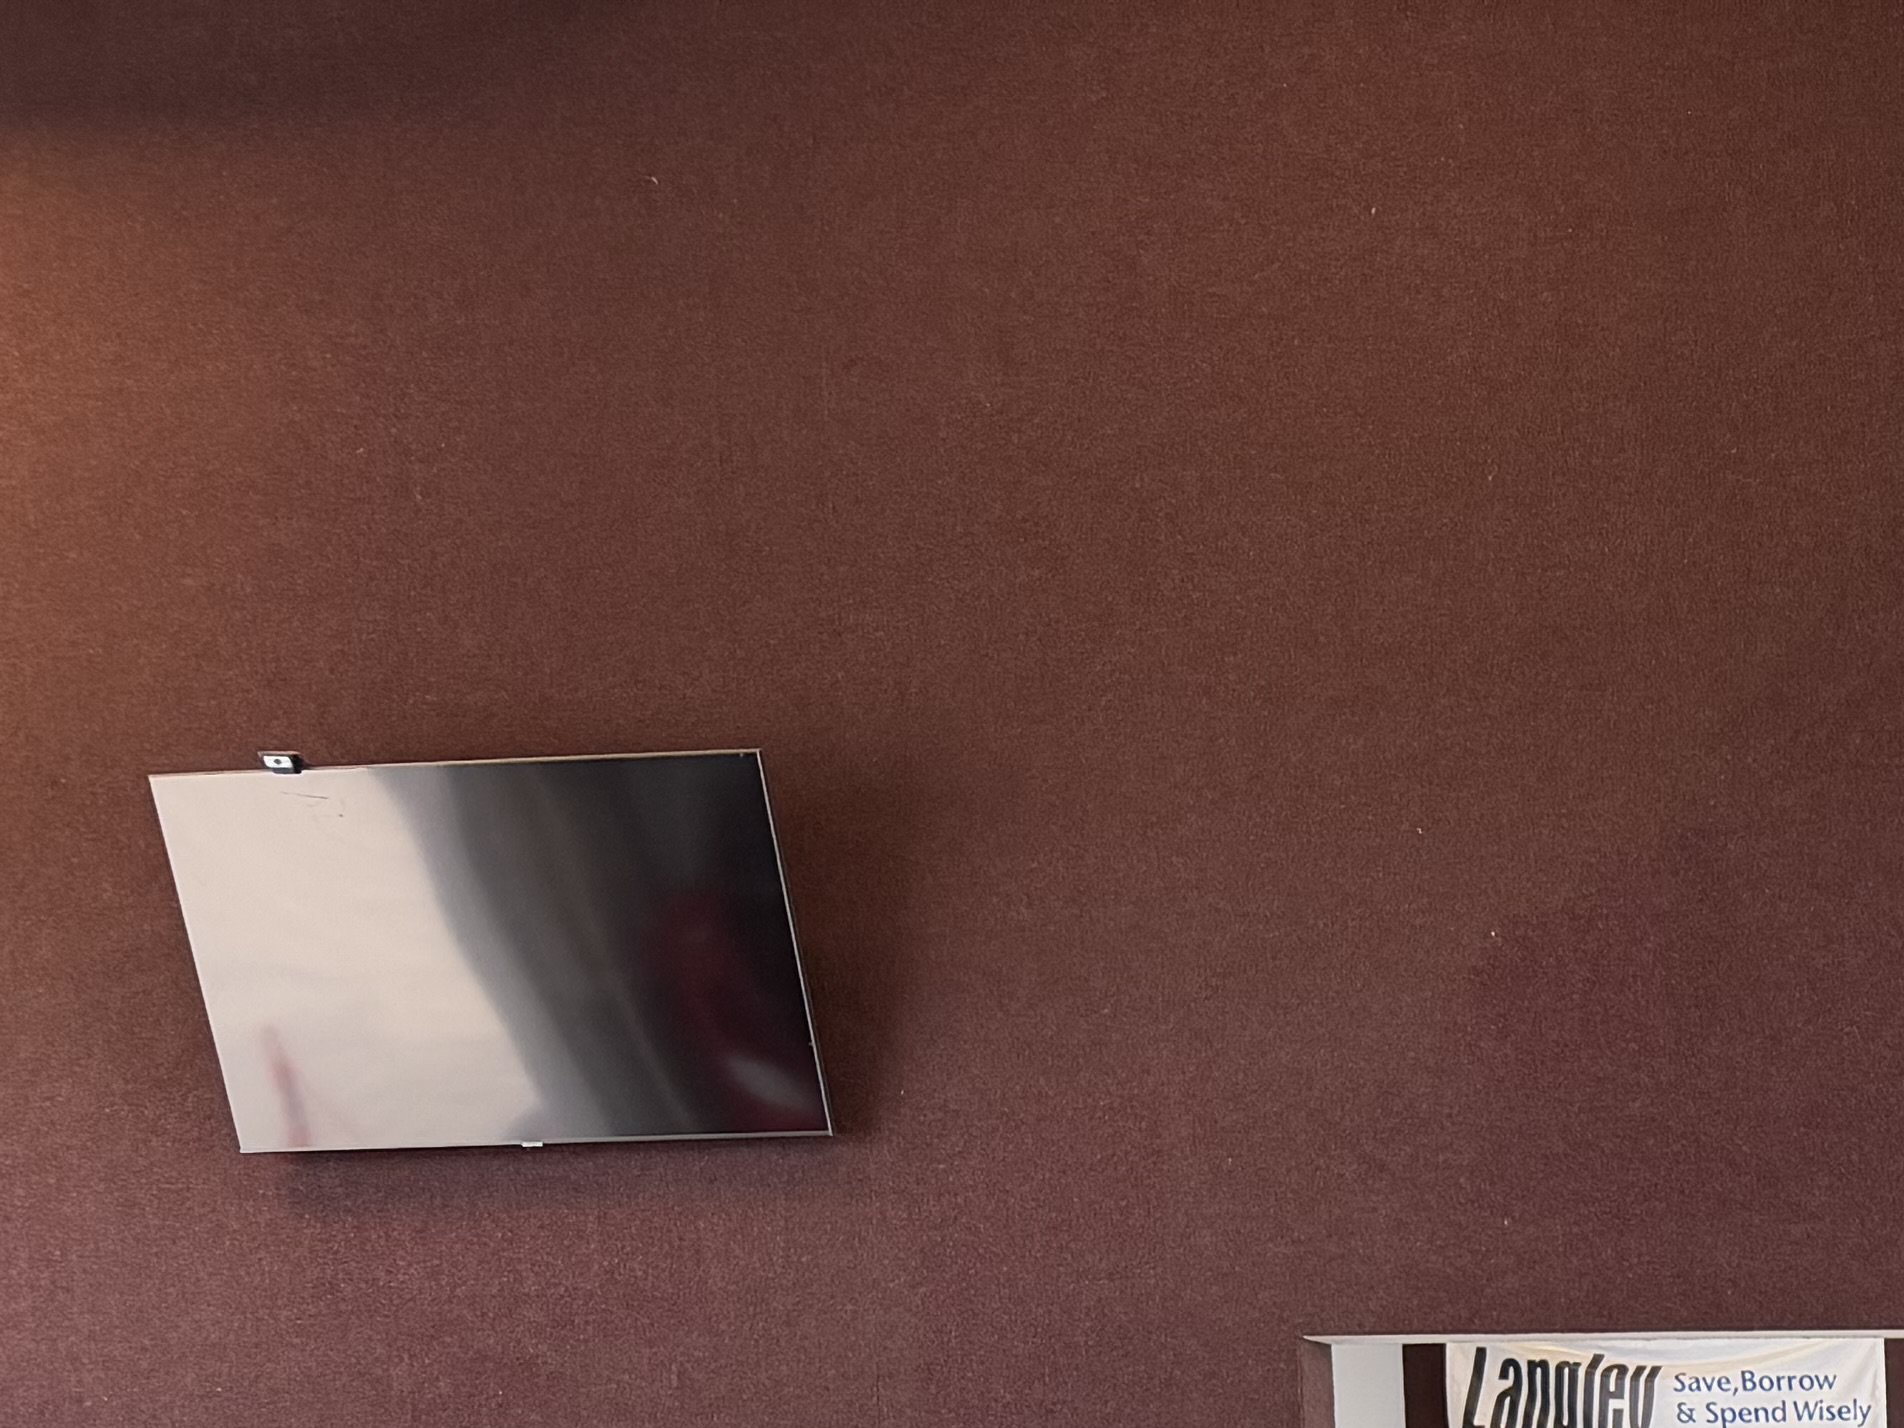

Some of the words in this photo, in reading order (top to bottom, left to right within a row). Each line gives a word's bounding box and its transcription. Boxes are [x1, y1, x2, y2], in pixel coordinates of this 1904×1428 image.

[1673, 1370, 1739, 1396] Save,
[1741, 1370, 1838, 1392] Borrow
[1675, 1402, 1697, 1424] &
[1791, 1399, 1872, 1427] Wisely
